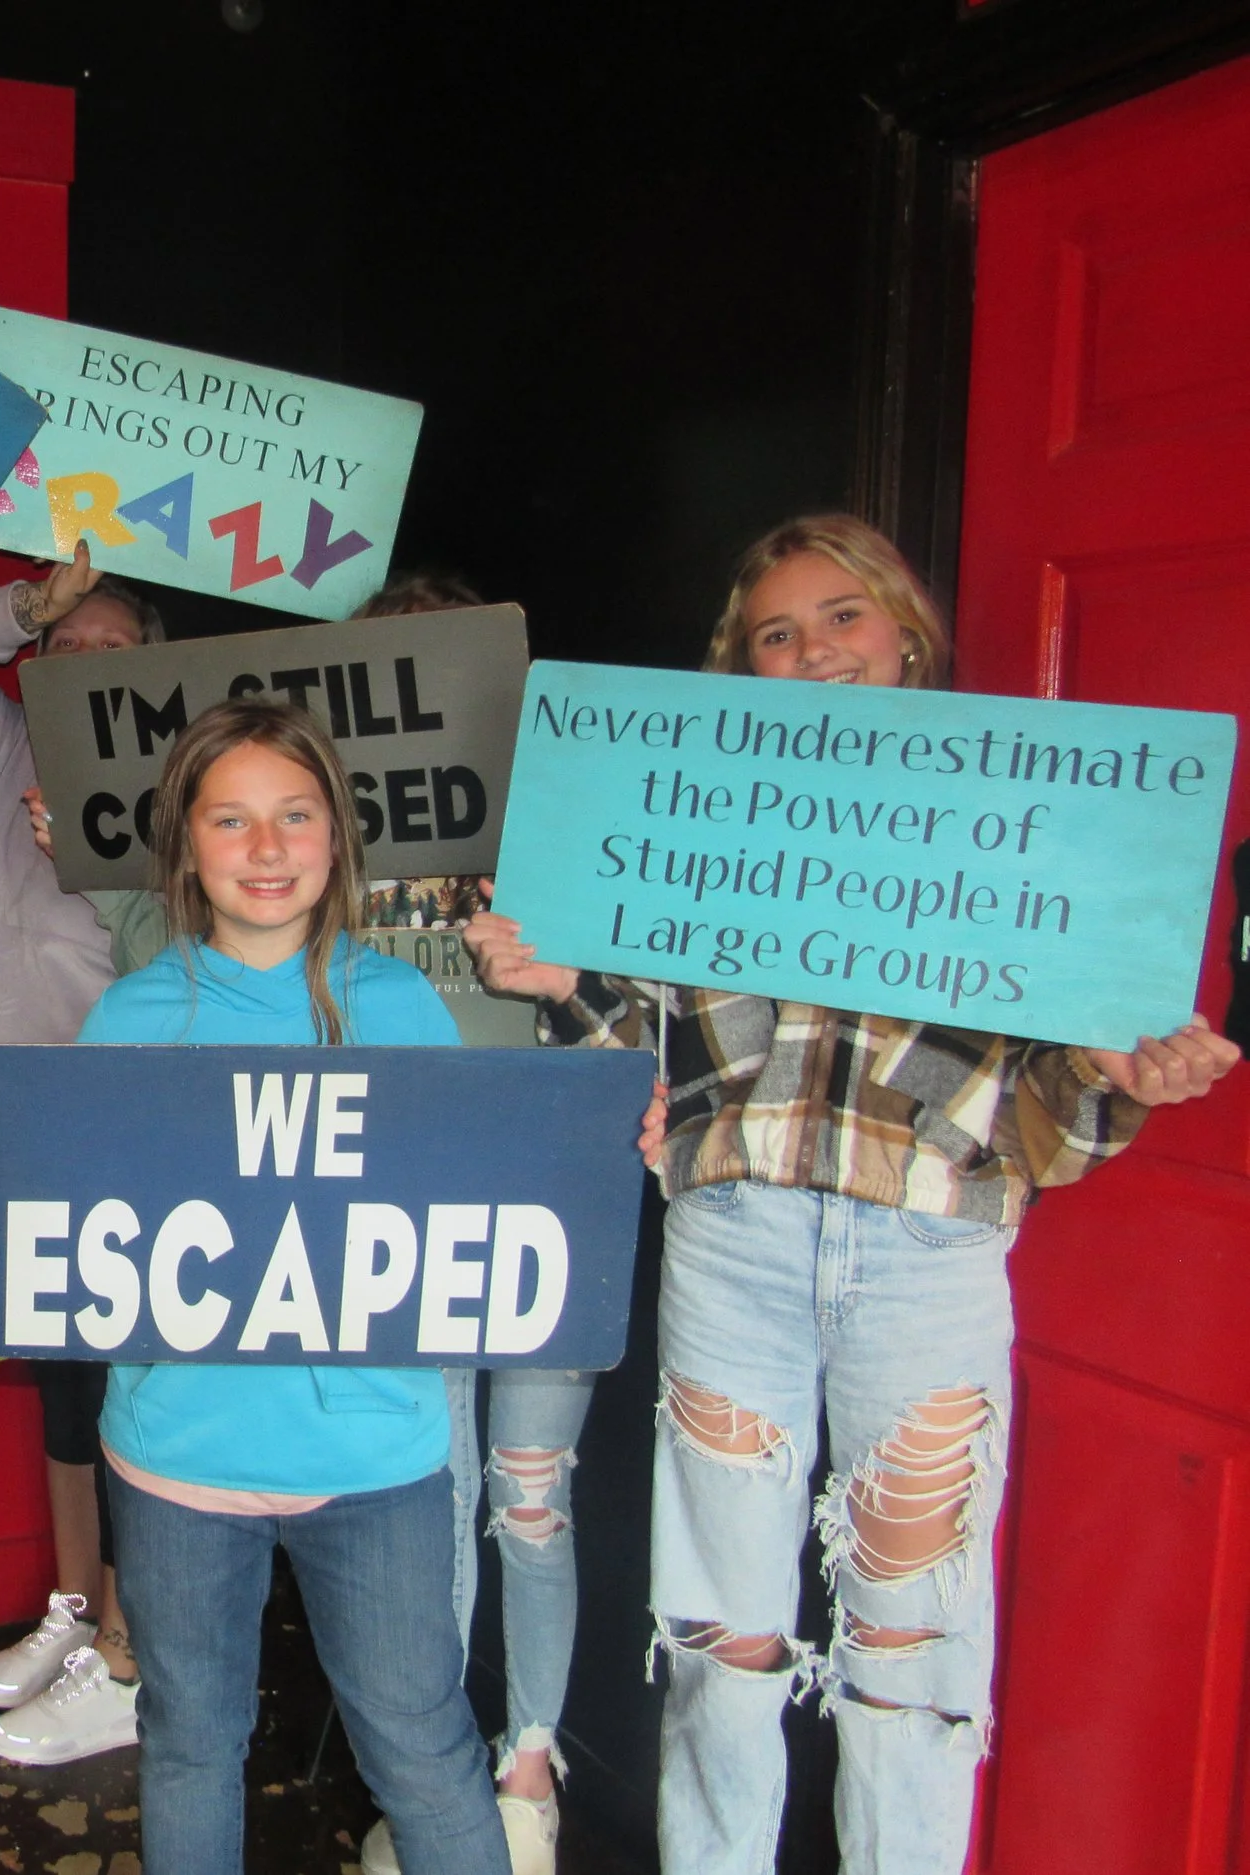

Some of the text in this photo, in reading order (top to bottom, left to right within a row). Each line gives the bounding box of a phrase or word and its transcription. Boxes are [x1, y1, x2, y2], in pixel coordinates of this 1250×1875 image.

[79, 347, 305, 427] ESCAPING
[33, 388, 362, 492] RINGS OUT MY
[88, 681, 188, 760] I'M
[533, 693, 1206, 797] Never Underestimate
[642, 770, 1050, 854] the Power of
[596, 833, 1071, 934] Stupid People in
[610, 904, 1029, 1009] Large Groups
[233, 1073, 369, 1177] WE
[5, 1198, 569, 1354] ESCAPED
